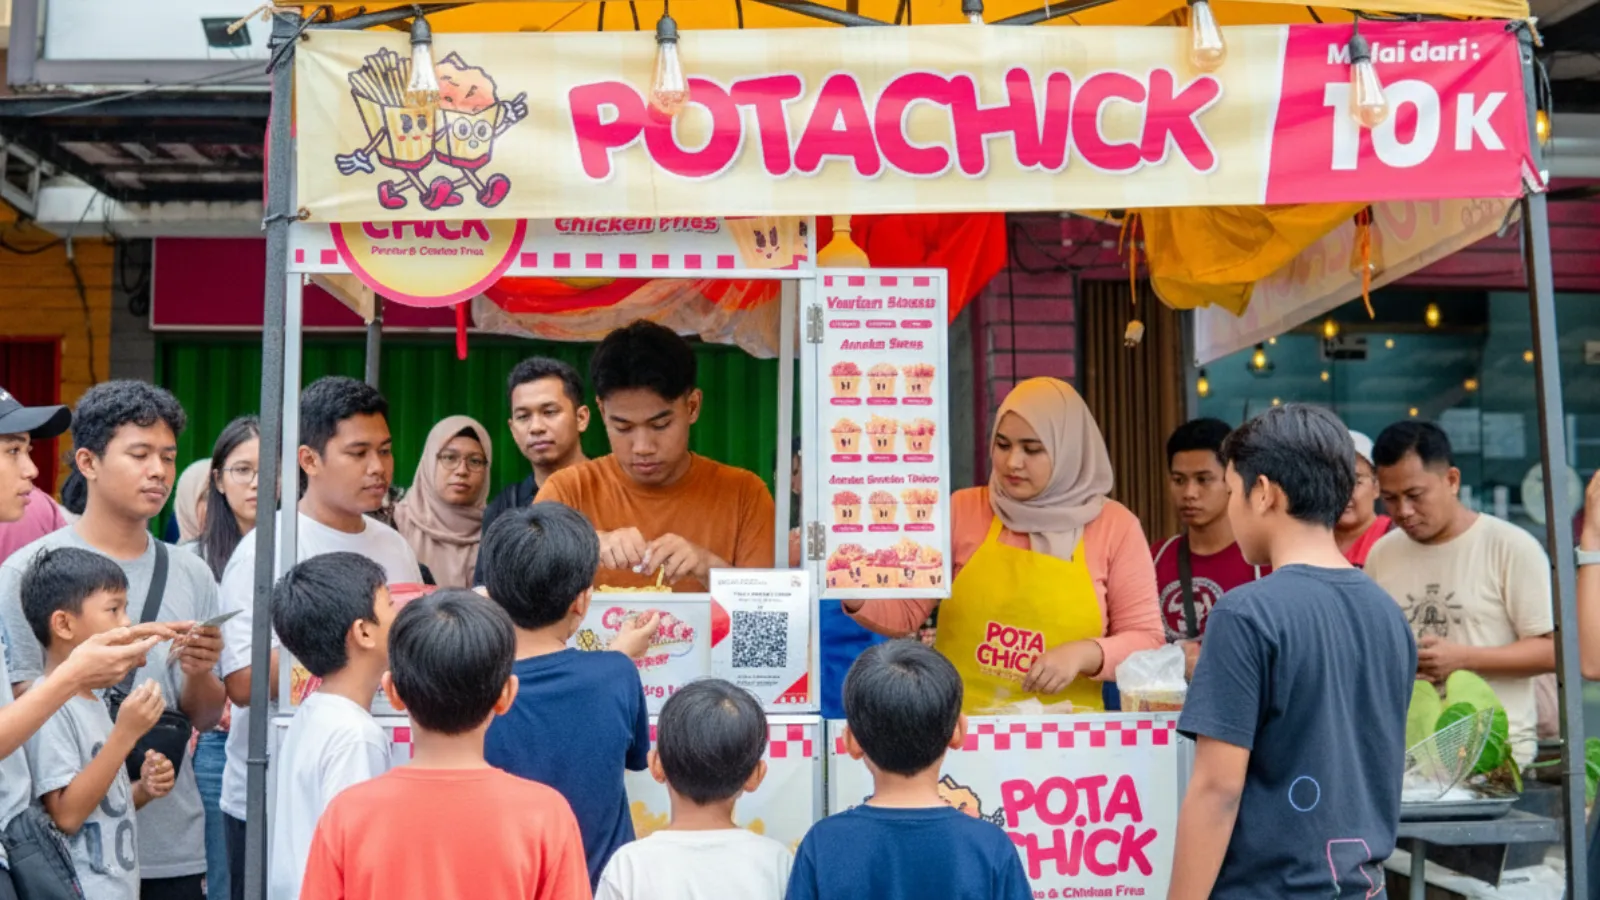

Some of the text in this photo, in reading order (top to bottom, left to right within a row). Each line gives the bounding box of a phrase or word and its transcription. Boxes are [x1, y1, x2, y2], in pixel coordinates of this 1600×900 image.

[1327, 40, 1406, 65] Mlai
[568, 68, 1221, 181] POTACHICK
[1323, 79, 1508, 171] 10 K
[986, 621, 1044, 654] POTA
[1001, 774, 1143, 828] POTA
